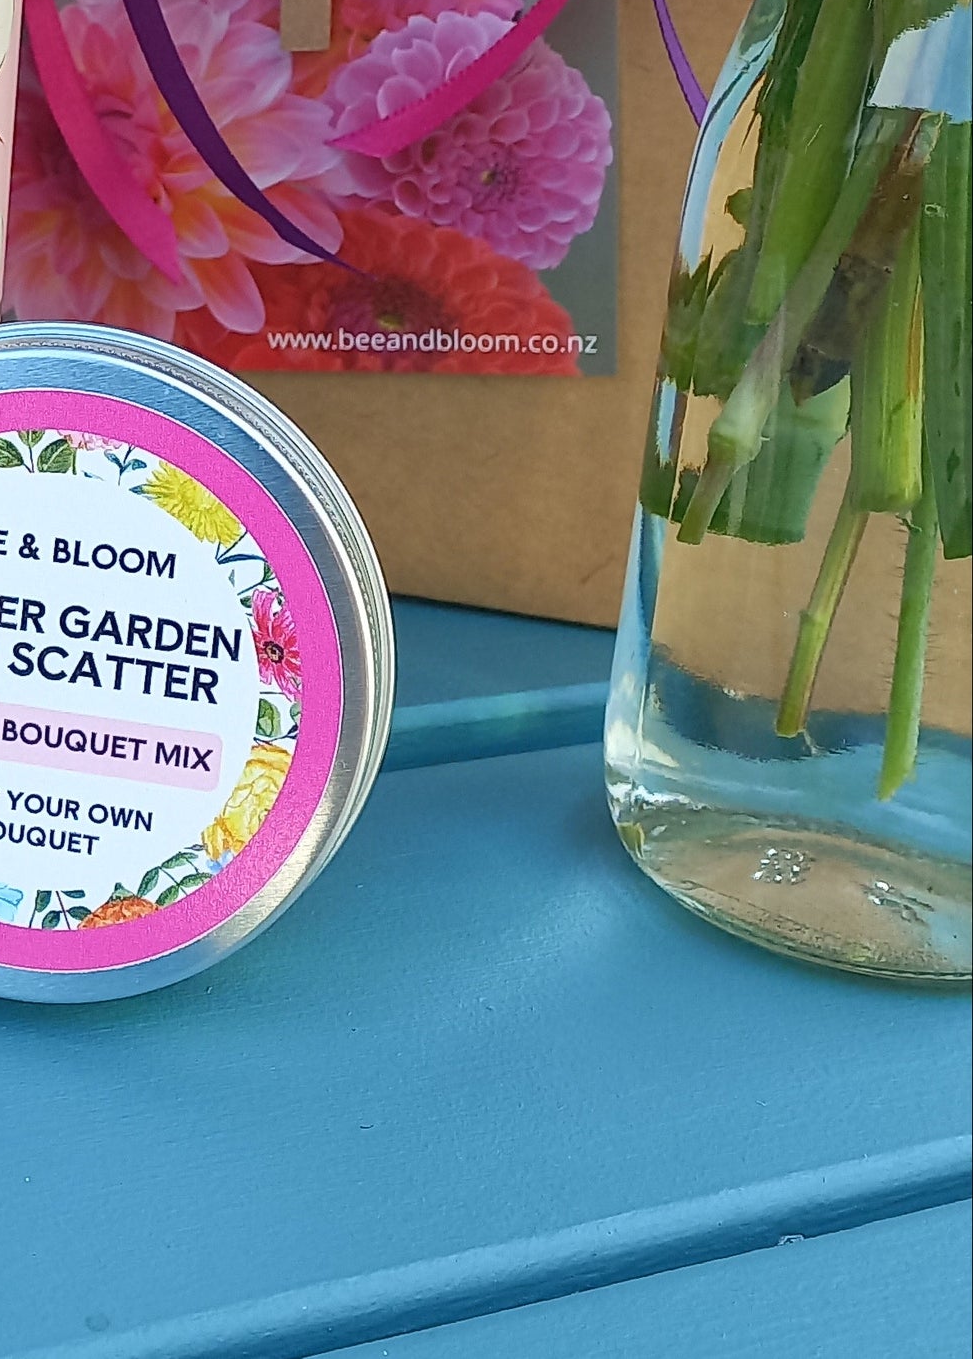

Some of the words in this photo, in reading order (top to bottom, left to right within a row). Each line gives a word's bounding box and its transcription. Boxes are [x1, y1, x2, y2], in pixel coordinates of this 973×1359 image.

[266, 328, 599, 355] www.beeandbloom.co.nz
[18, 532, 41, 561] &
[52, 537, 177, 579] BLOOM
[58, 604, 243, 662] GARDEN
[7, 641, 220, 705] SCATTER
[1, 718, 148, 762] BOUQUET
[154, 742, 215, 773] MIX
[7, 790, 81, 821] YOUR
[88, 803, 154, 832] OWN
